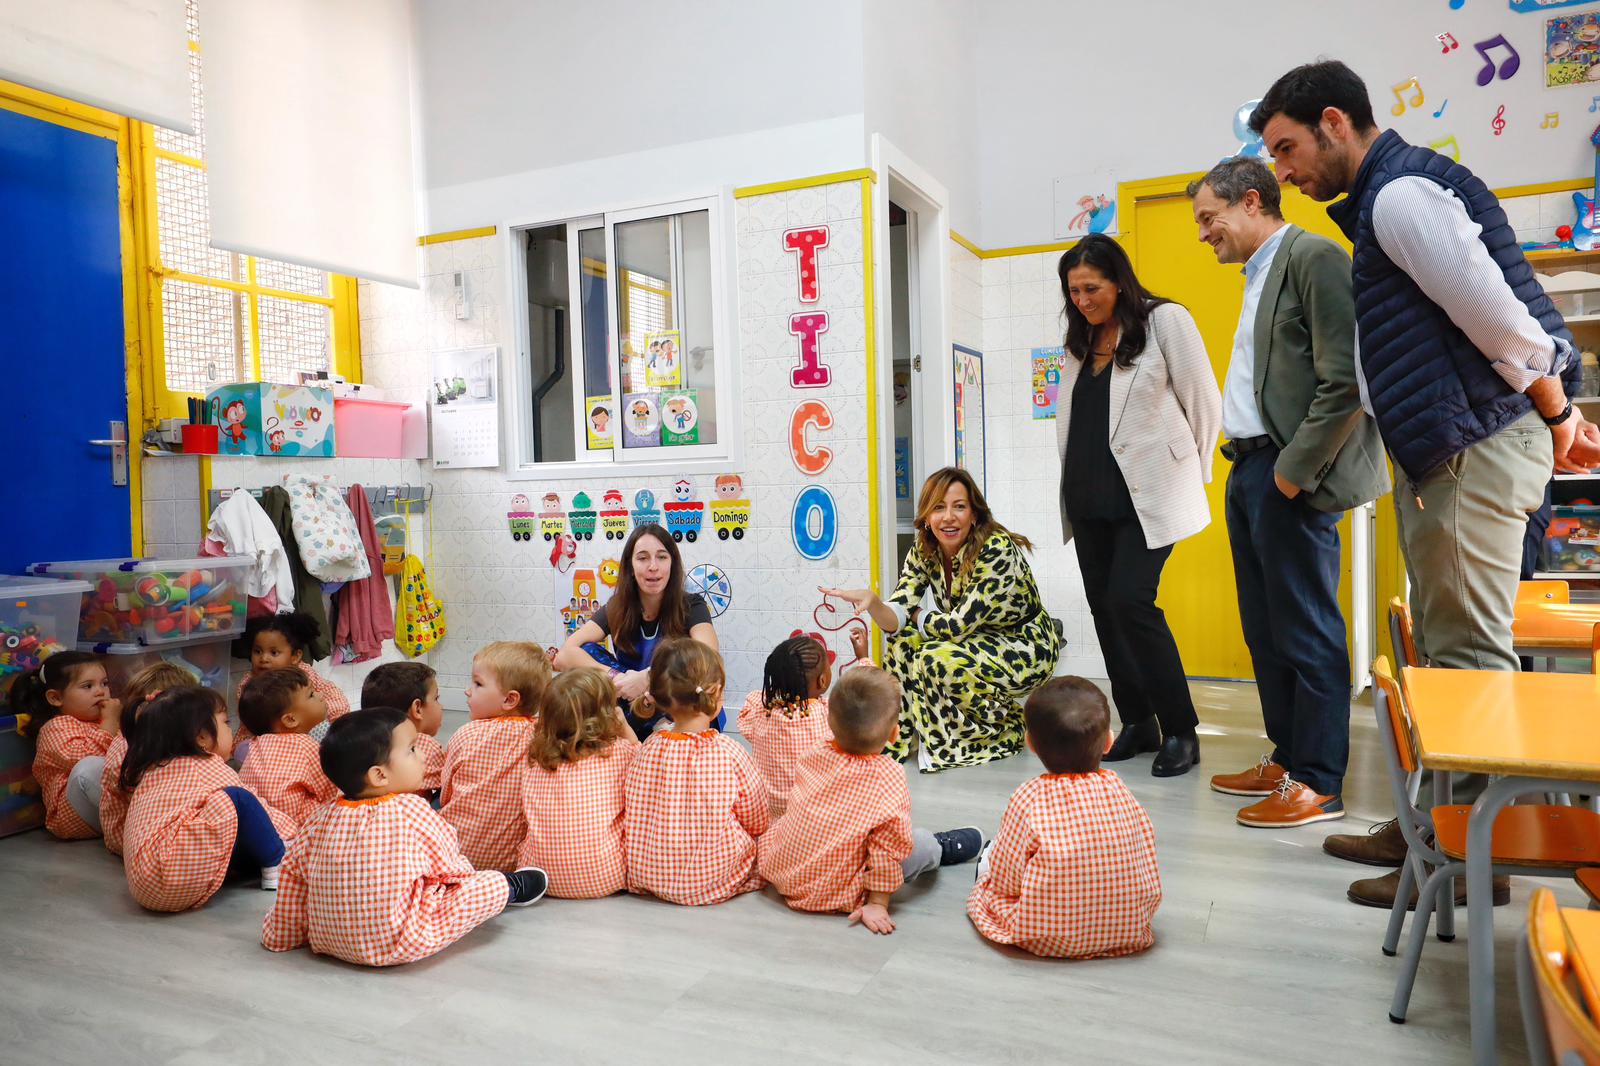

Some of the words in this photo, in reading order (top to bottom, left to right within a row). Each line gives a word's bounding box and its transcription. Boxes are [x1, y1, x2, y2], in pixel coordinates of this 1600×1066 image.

[783, 225, 838, 560] TICO
[713, 511, 749, 525] Domingo
[512, 520, 530, 528] Lunes
[541, 520, 563, 529] Martes
[603, 519, 626, 527] Jueves
